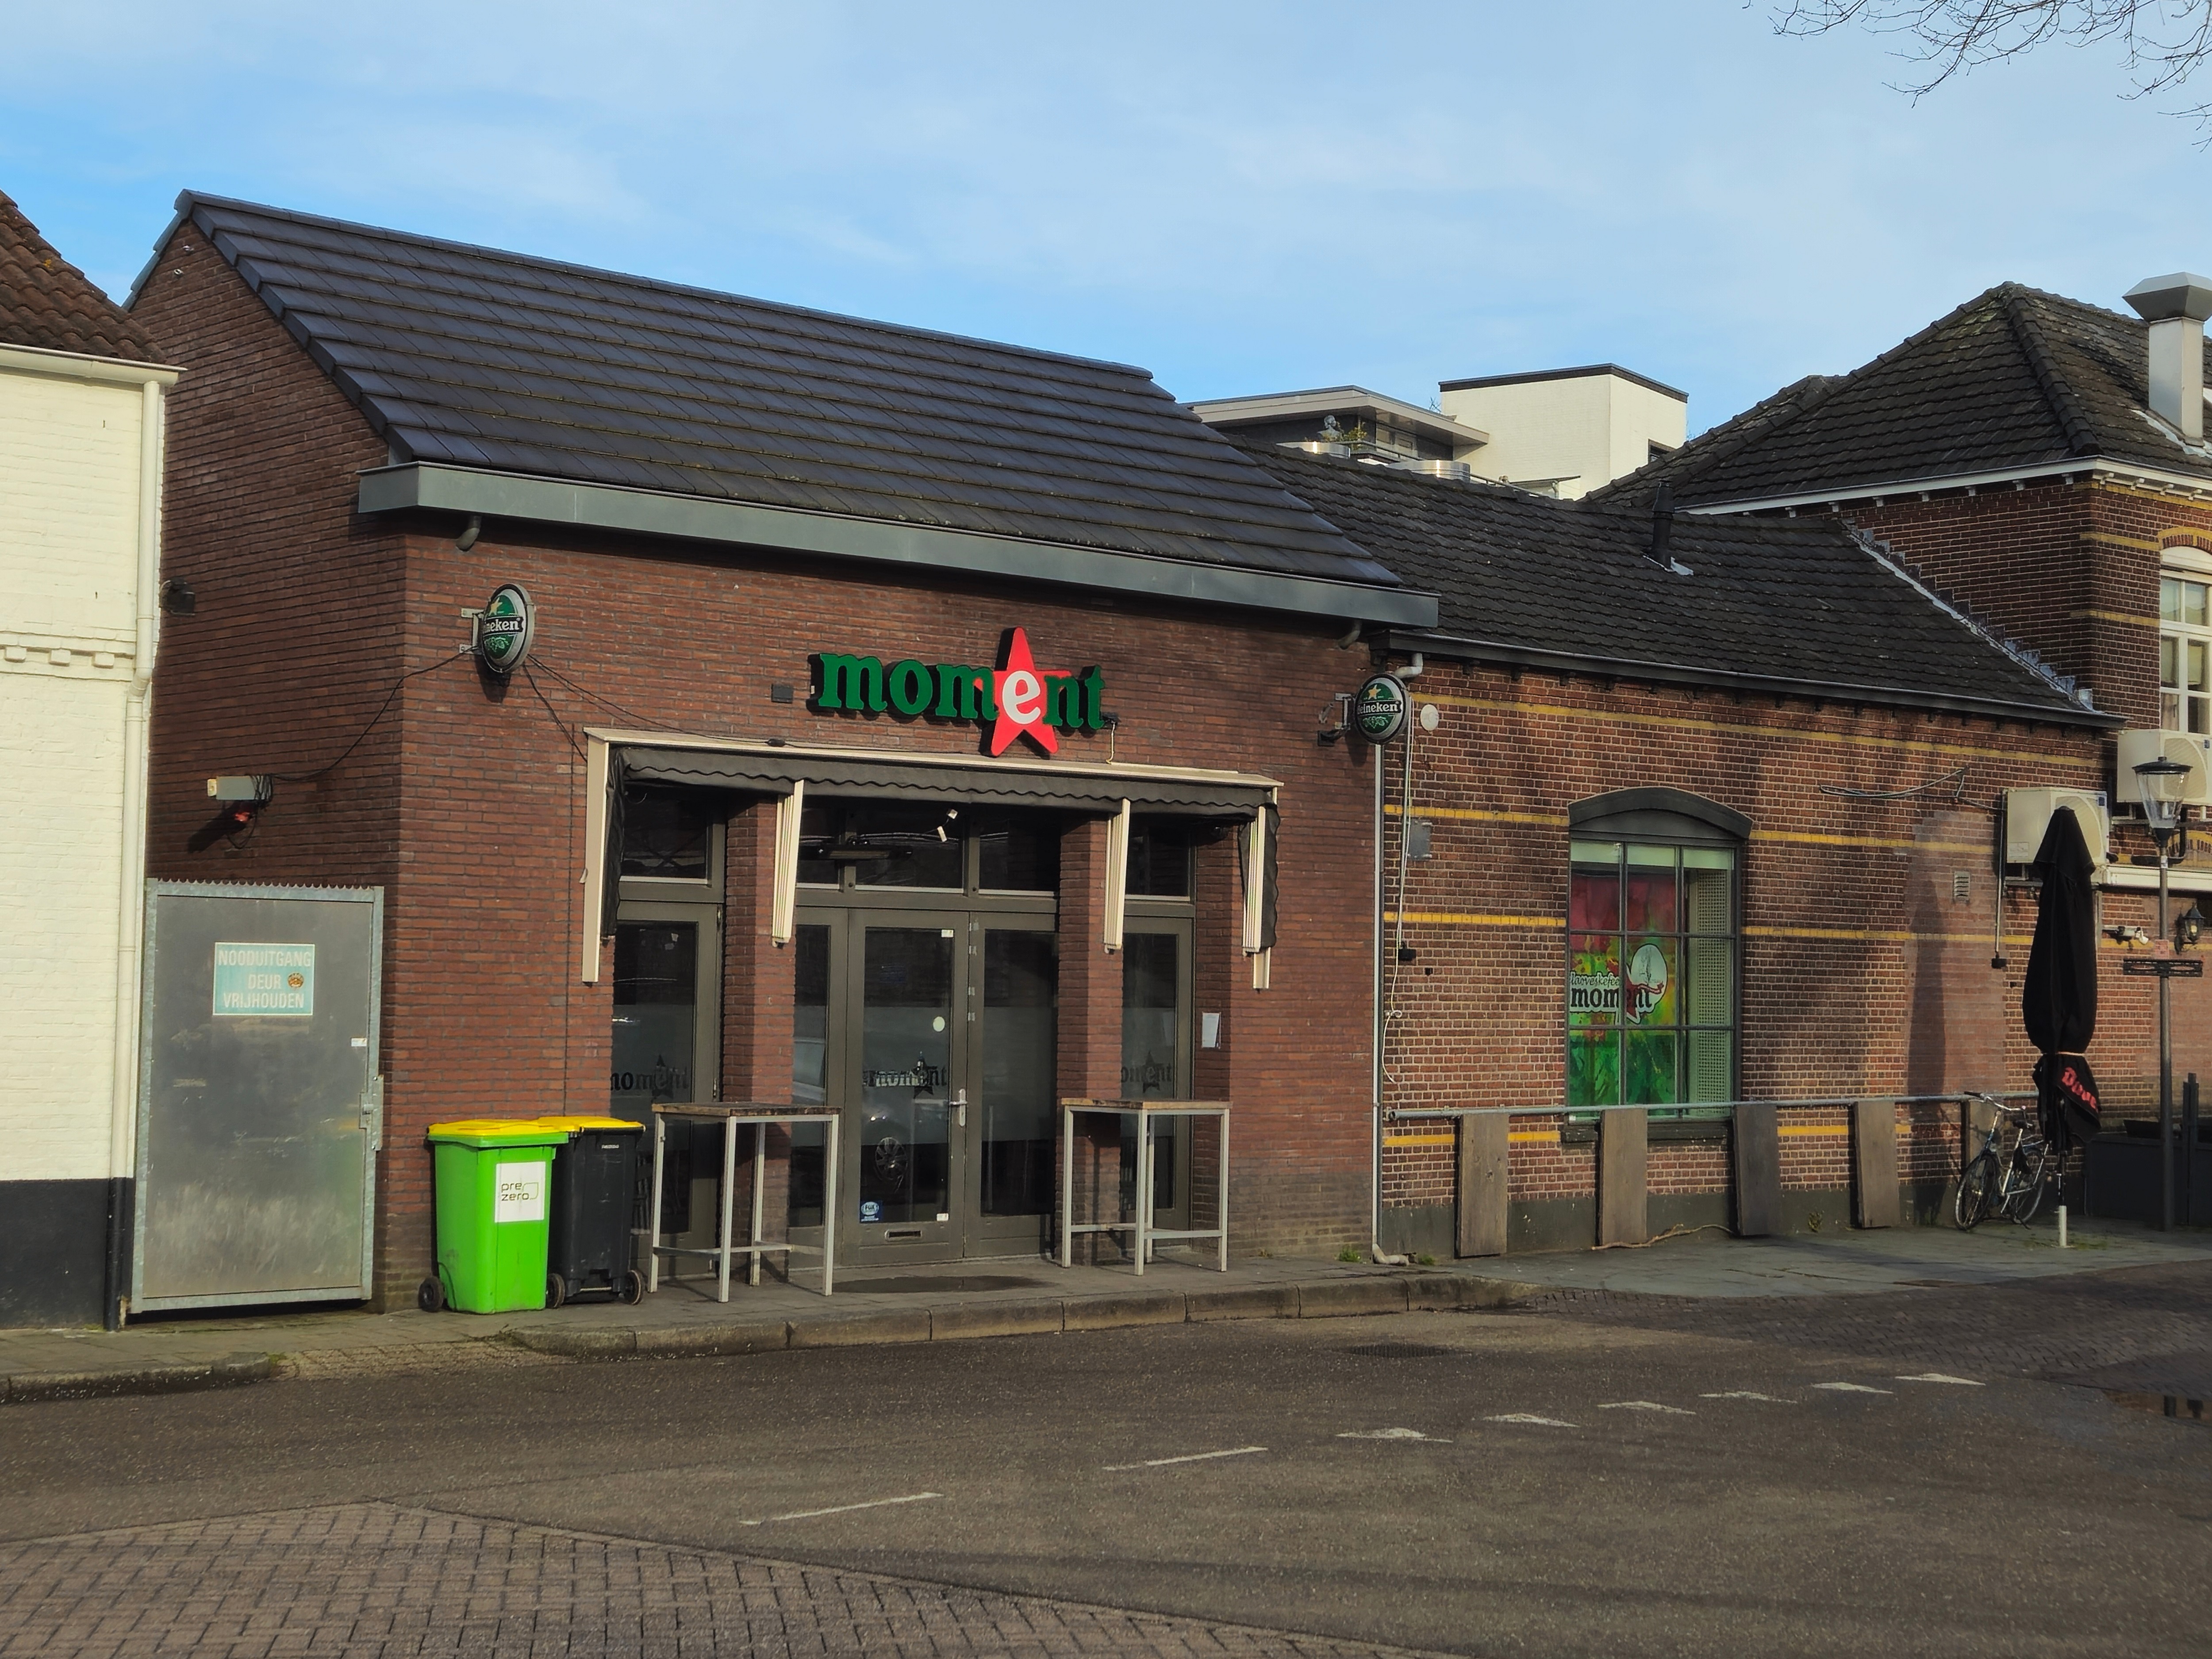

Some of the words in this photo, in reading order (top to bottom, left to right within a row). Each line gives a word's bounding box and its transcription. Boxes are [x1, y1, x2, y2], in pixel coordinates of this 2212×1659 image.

[818, 653, 1106, 730] moment
[218, 950, 311, 967] NOODUITGANG
[248, 974, 281, 990] DEUR
[224, 992, 304, 1008] VRIJHOUDEN
[1571, 987, 1652, 1008] momnt
[501, 1183, 522, 1193] pre
[501, 1193, 529, 1201] zero
